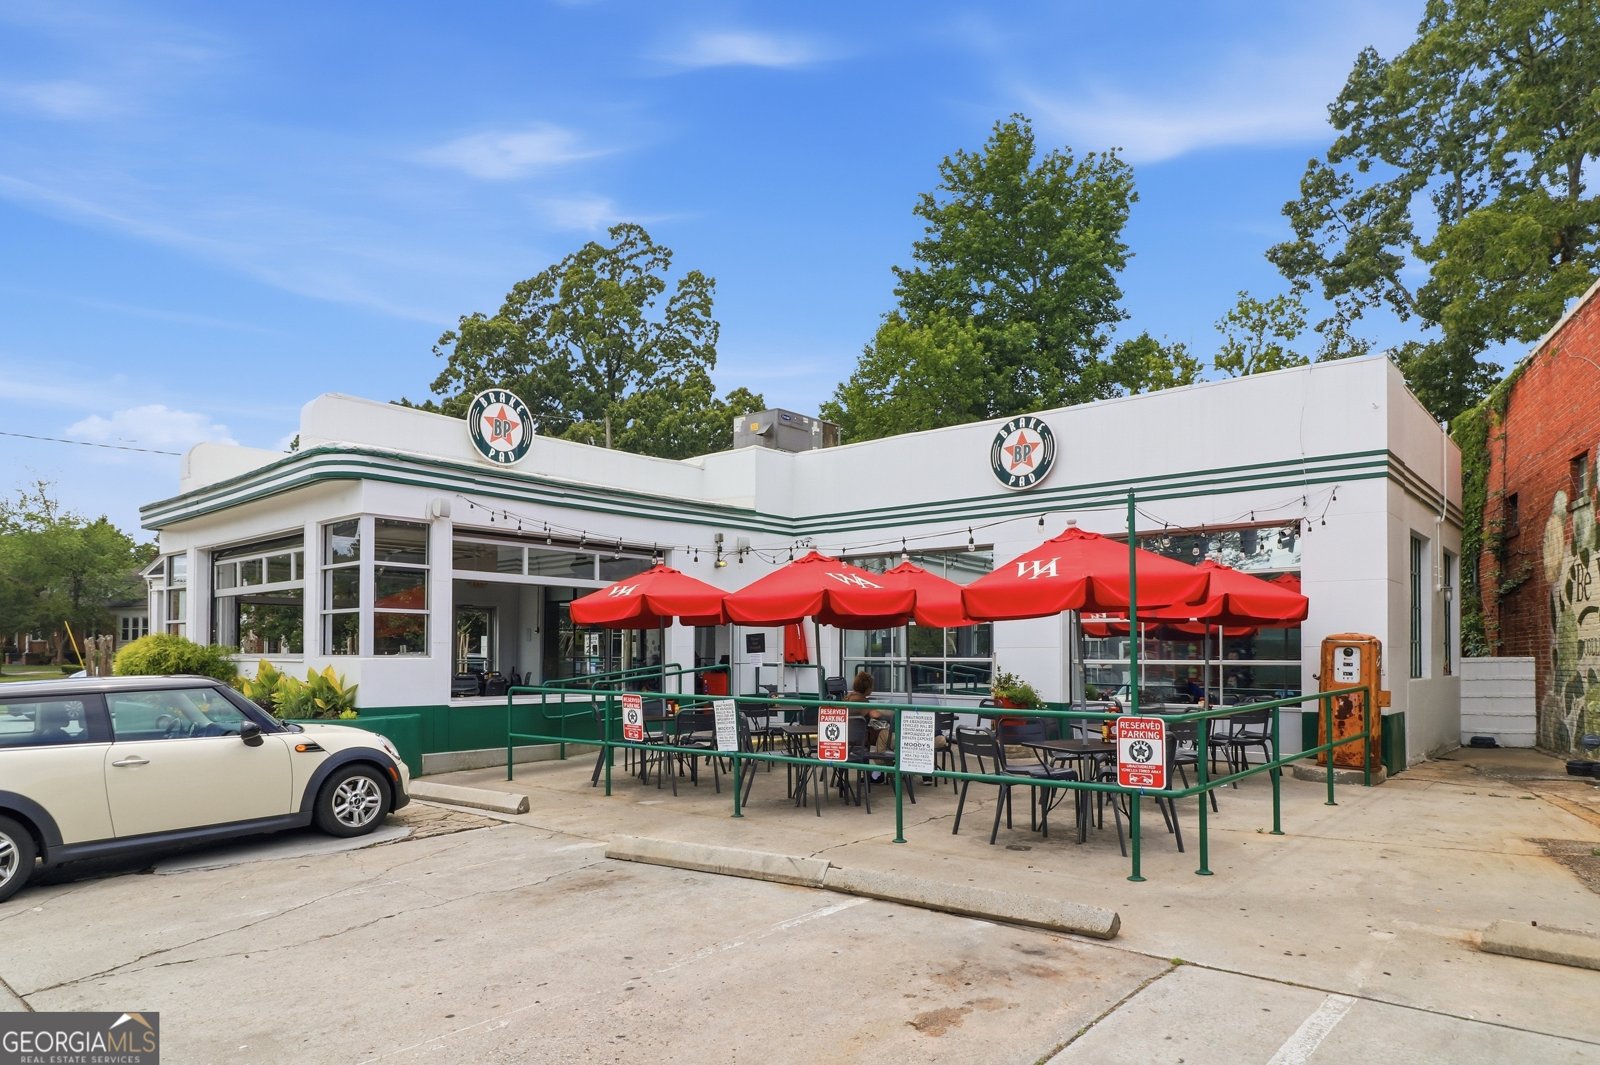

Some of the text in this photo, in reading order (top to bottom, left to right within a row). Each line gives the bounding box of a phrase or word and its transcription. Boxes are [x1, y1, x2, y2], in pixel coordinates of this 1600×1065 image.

[479, 392, 524, 414] BRAKE
[494, 418, 511, 438] BP
[999, 417, 1045, 438] BRAKE
[488, 448, 515, 462] PAD
[1014, 444, 1031, 463] BP
[1008, 473, 1036, 486] PAD
[1575, 563, 1592, 602] Be
[1120, 721, 1161, 731] RESERVED
[1121, 730, 1160, 740] PARKING
